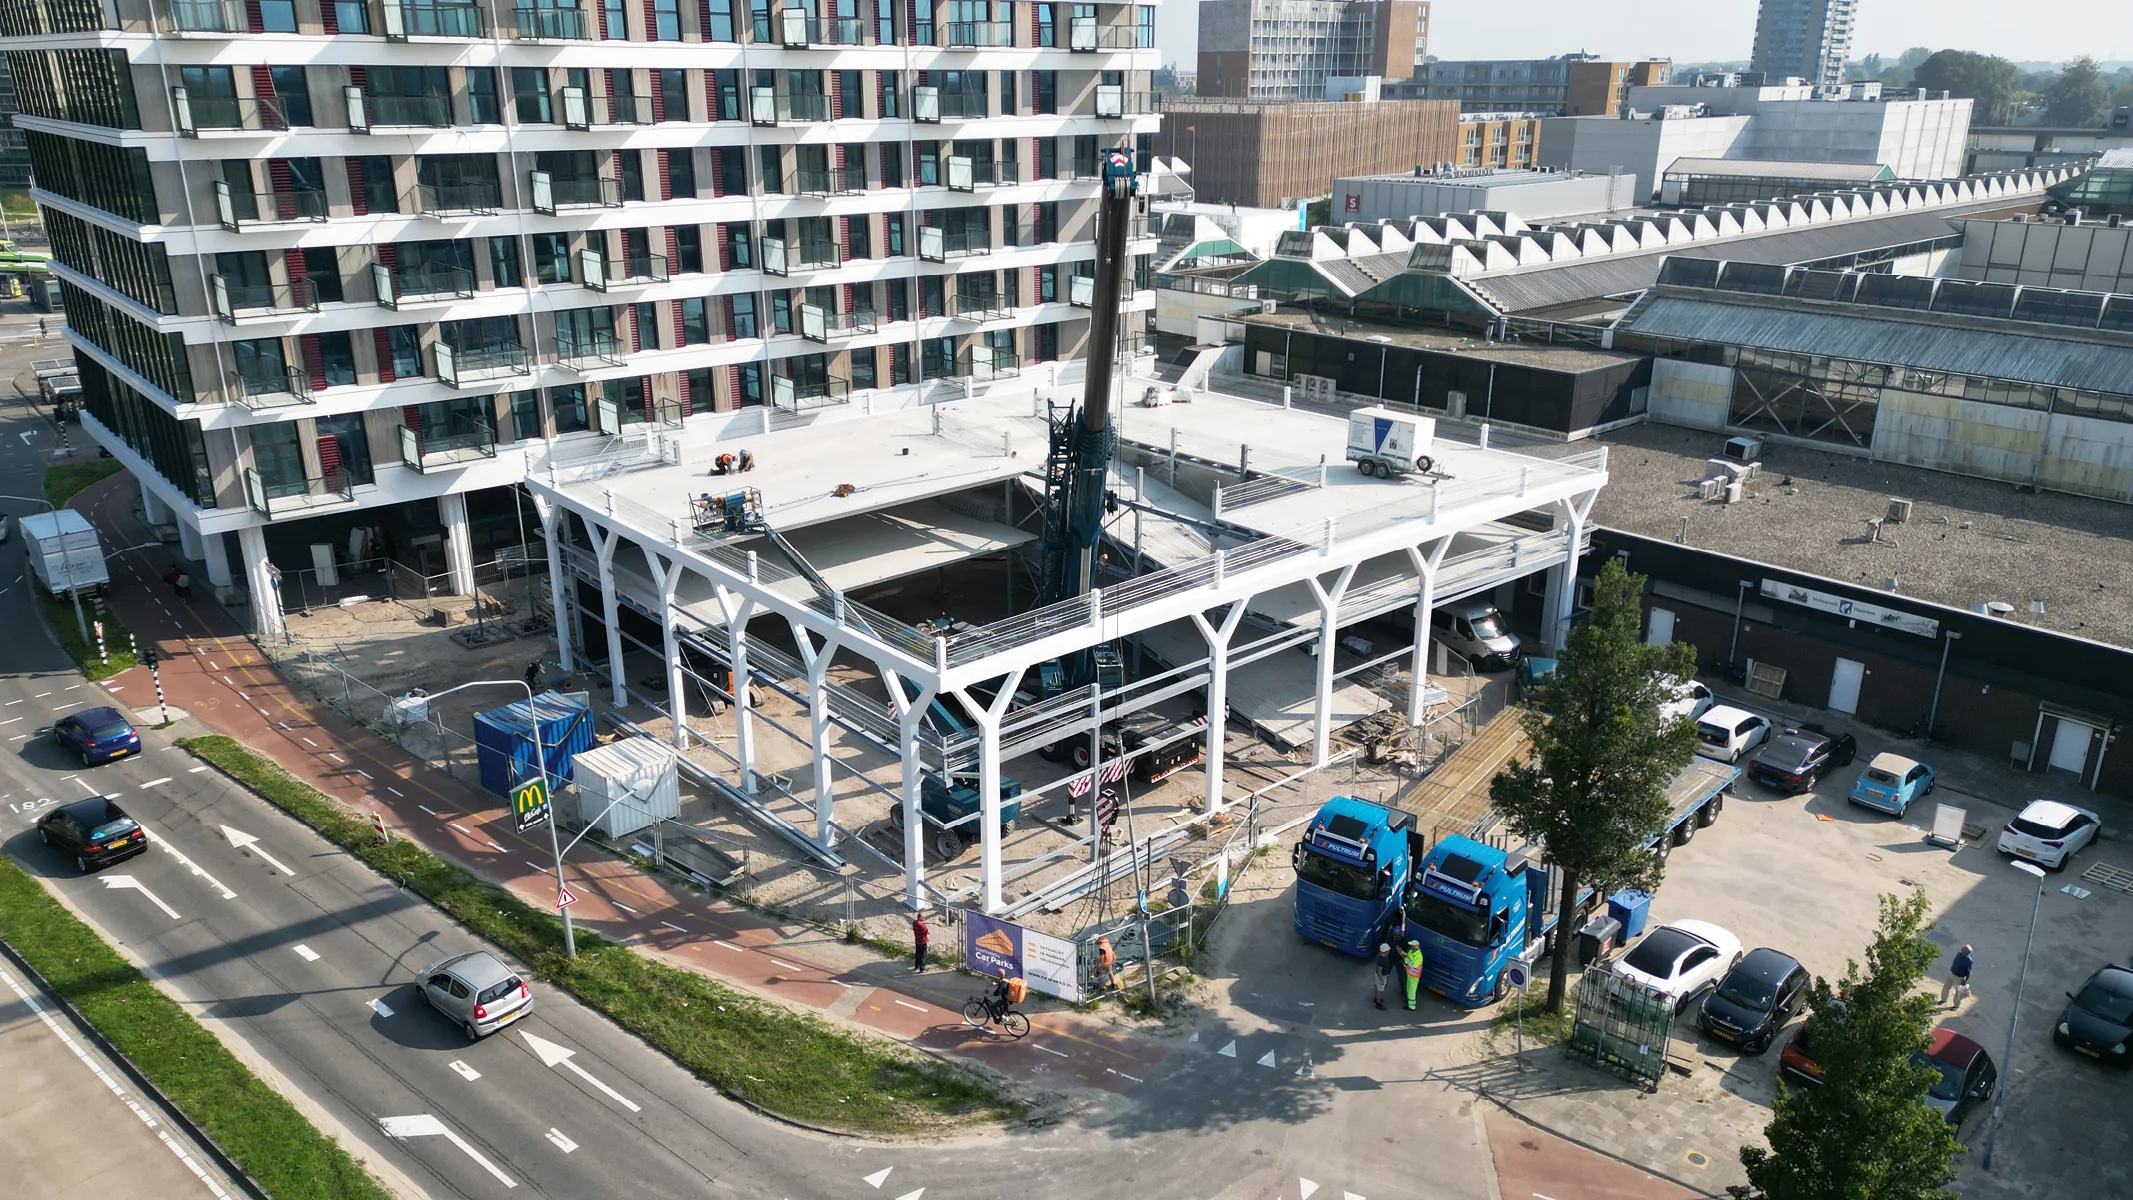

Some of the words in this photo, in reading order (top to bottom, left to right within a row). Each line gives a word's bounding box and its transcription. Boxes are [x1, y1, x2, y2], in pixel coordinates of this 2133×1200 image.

[1349, 197, 1356, 208] S
[1327, 843, 1360, 857] PULTRUM
[1439, 885, 1473, 901] PULTRUM
[975, 952, 990, 962] Car
[990, 957, 1014, 970] Parks
